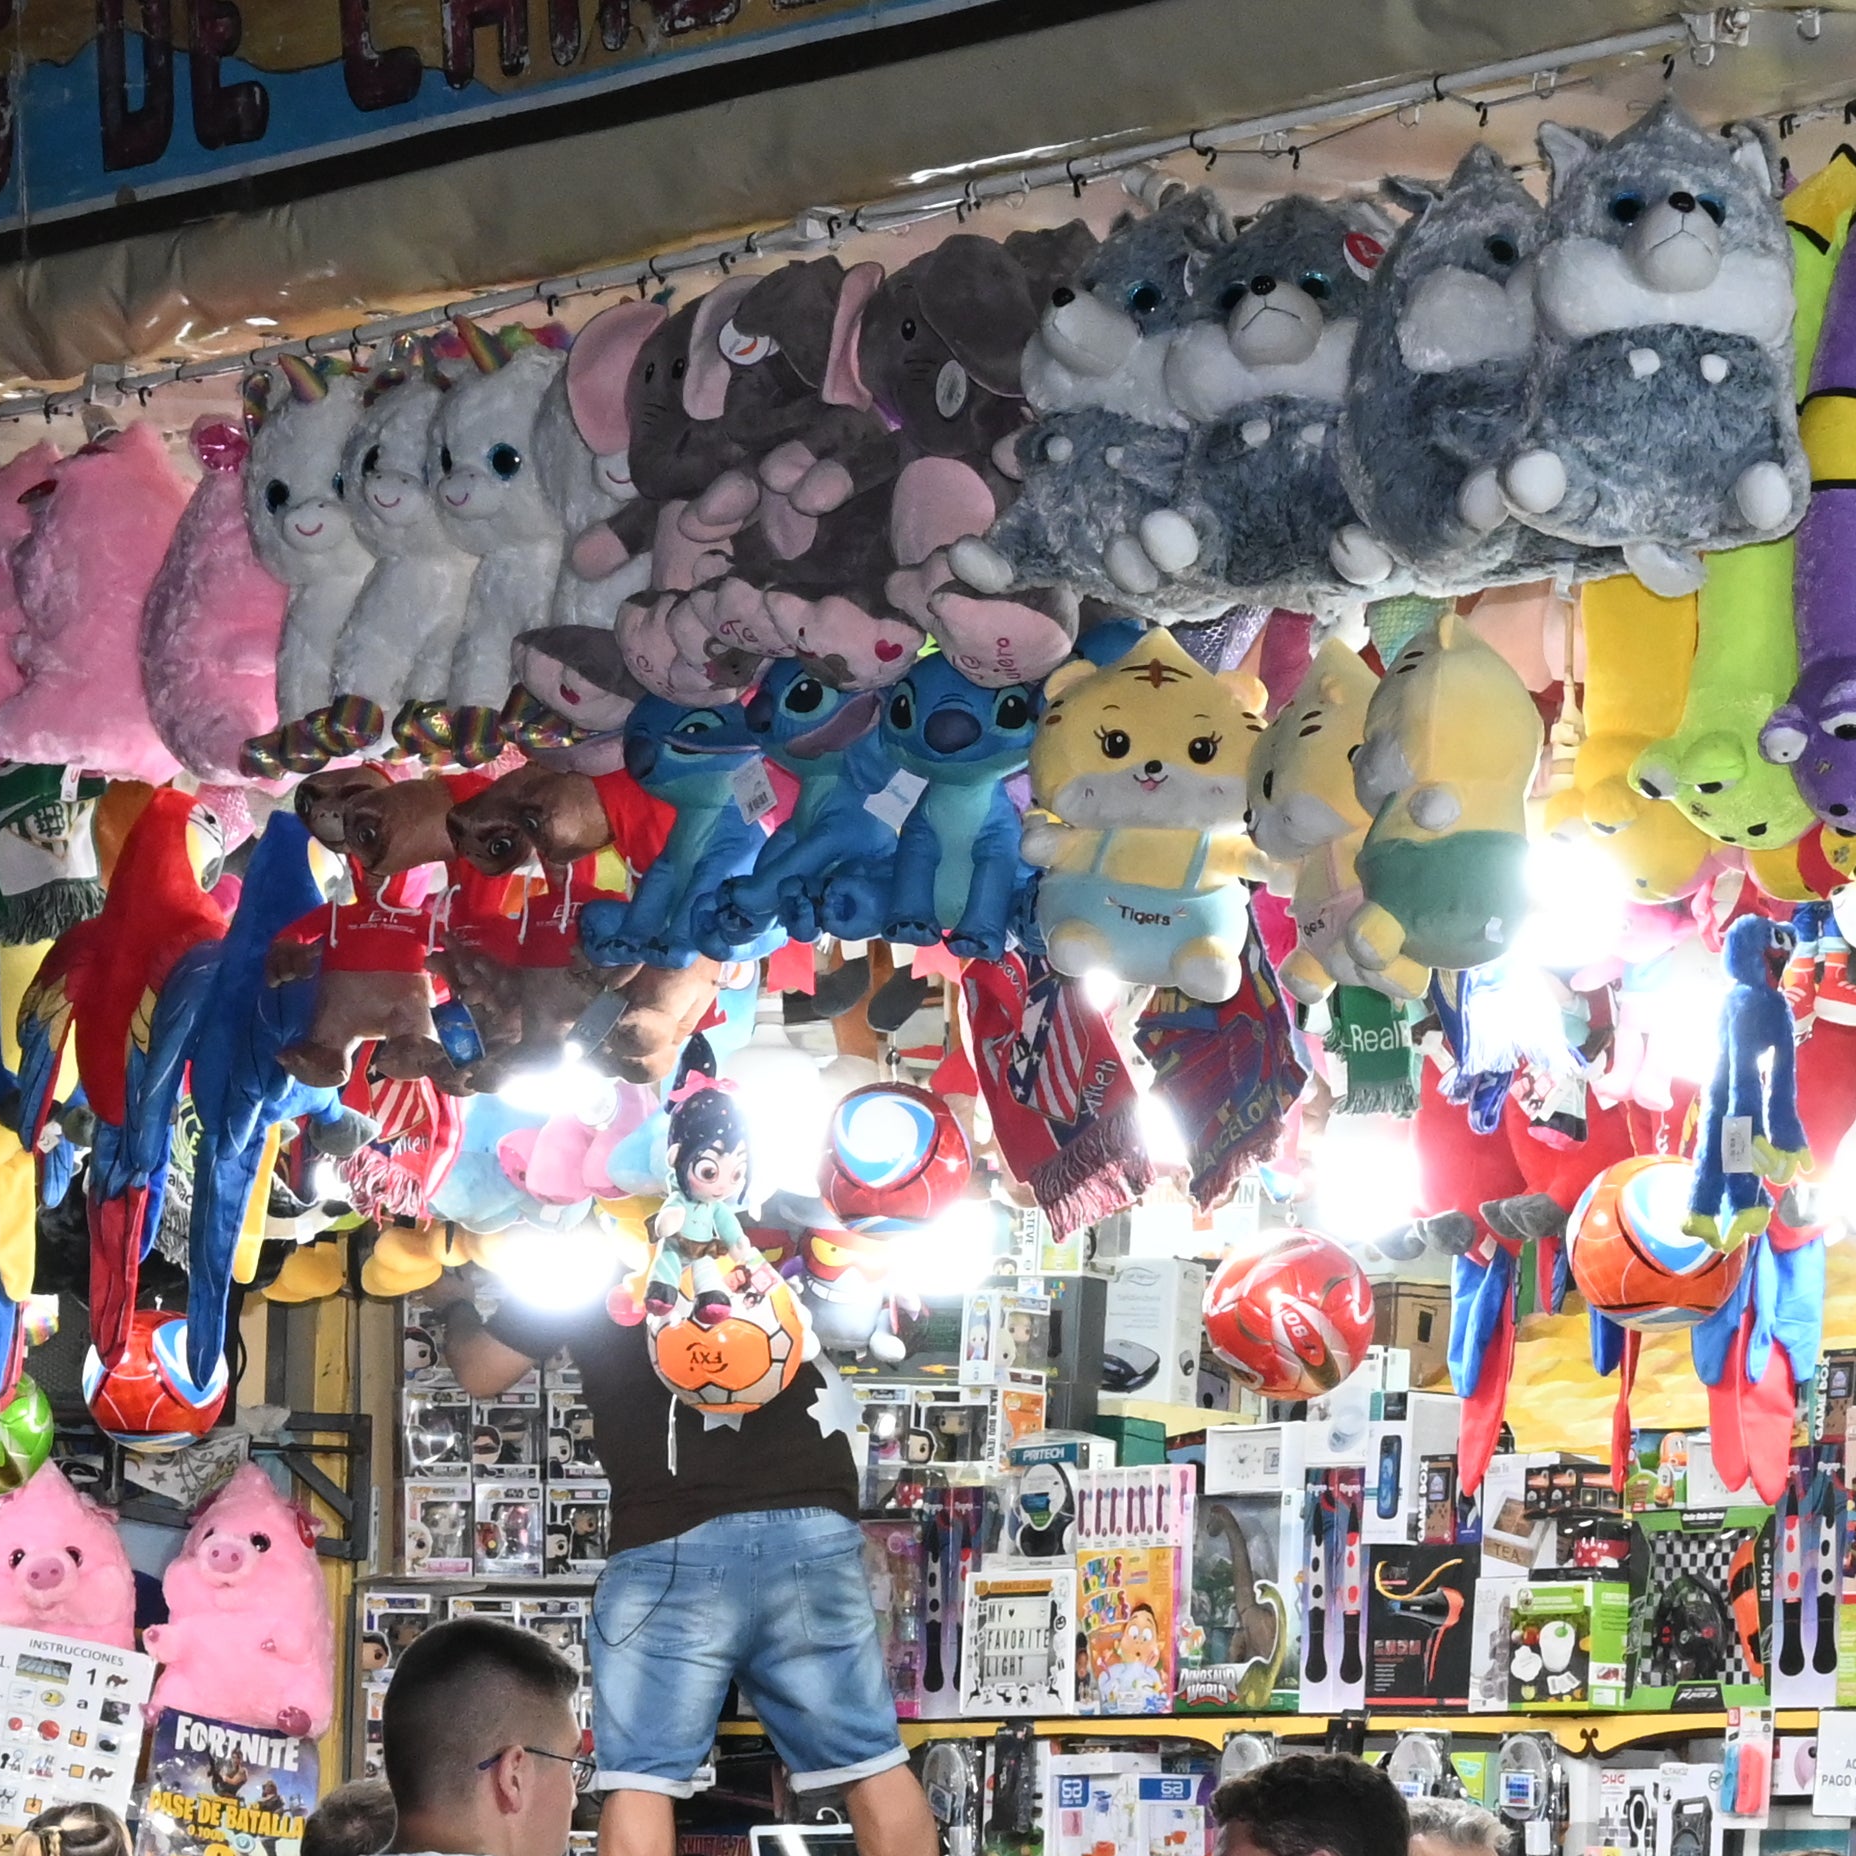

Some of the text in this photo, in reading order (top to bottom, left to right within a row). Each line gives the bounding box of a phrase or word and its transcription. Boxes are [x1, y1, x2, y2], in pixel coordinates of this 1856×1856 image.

[98, 0, 269, 172] DE
[1022, 1449, 1065, 1462] PRITECH
[988, 1604, 1004, 1621] MY
[987, 1629, 1050, 1650] FAVORITE
[29, 1638, 125, 1667] INSTRUCCIONES
[985, 1655, 1025, 1677] LIGHT
[1186, 1683, 1228, 1702] WORLD
[175, 1714, 301, 1772] FORTNITE
[1821, 1775, 1852, 1788] PAGO
[201, 1798, 224, 1829] DE
[225, 1802, 306, 1841] BATALLA
